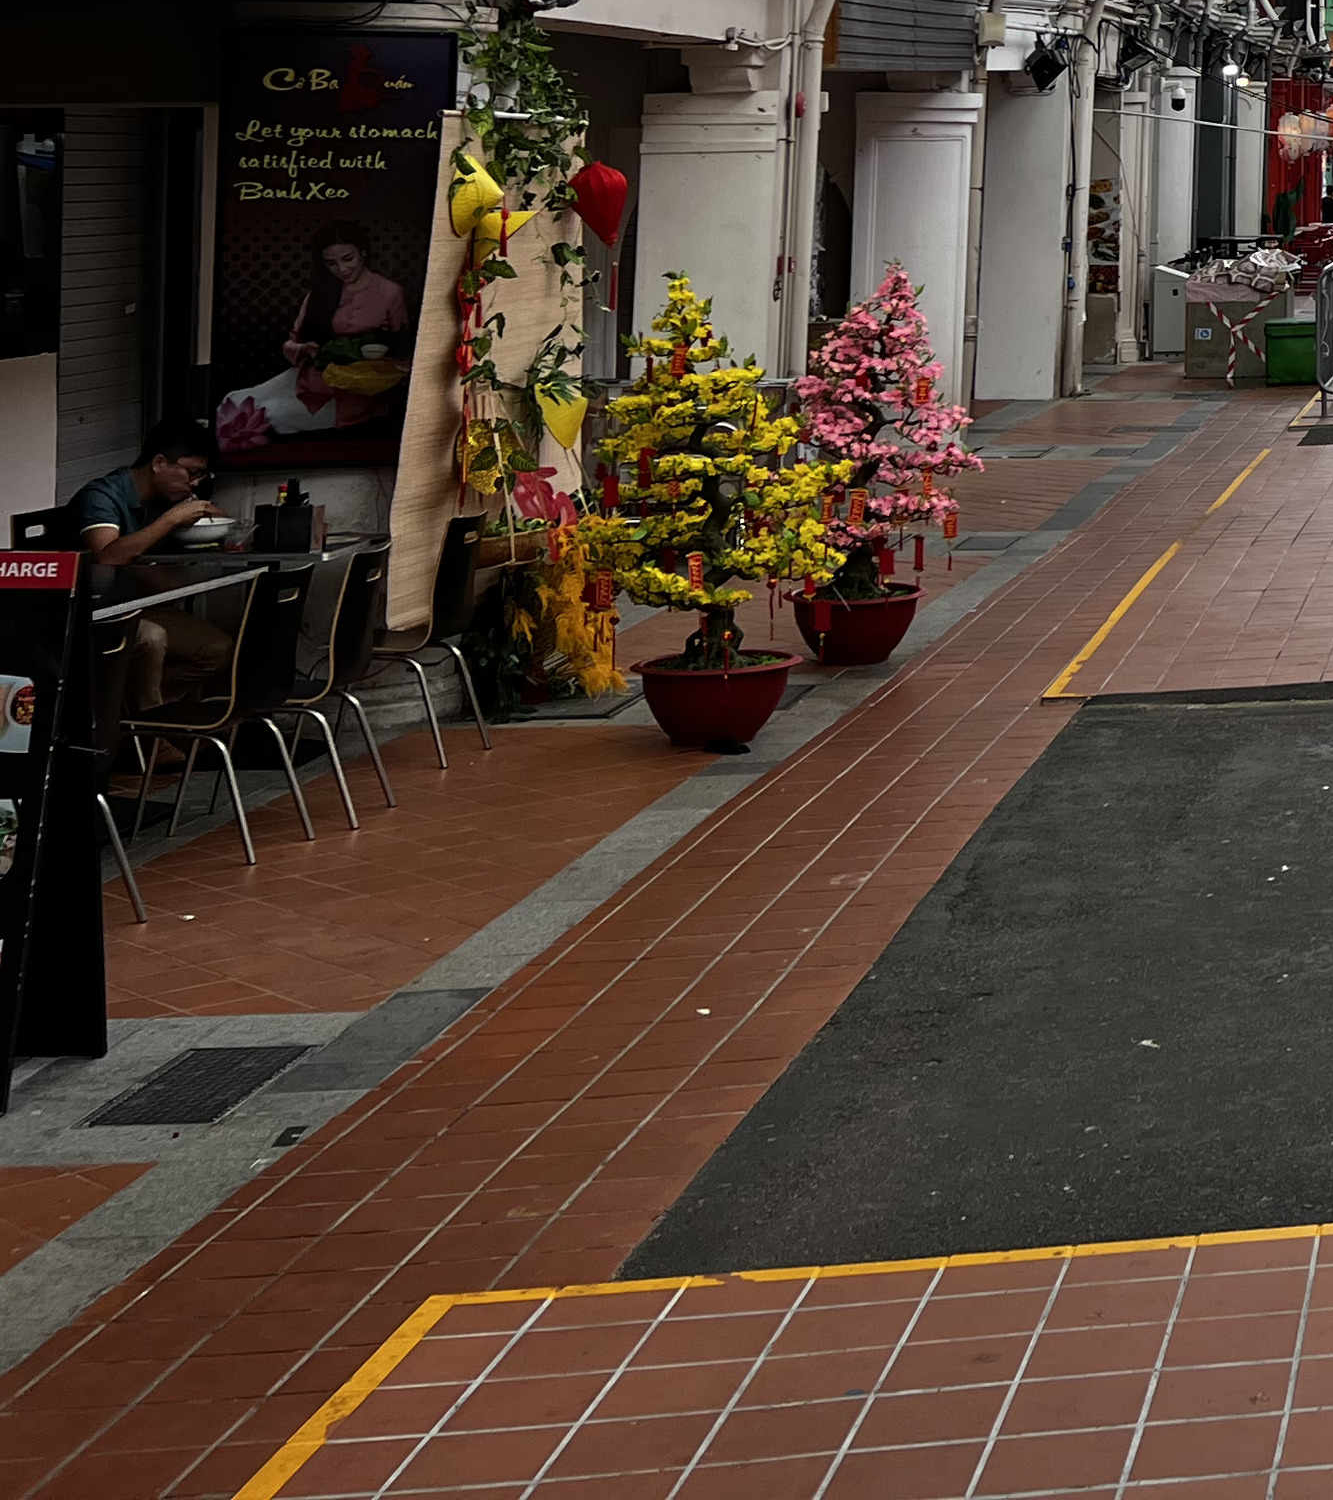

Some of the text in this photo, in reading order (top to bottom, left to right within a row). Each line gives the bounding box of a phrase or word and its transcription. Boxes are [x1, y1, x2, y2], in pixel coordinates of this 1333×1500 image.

[235, 119, 439, 147] Let your stomach
[238, 150, 389, 178] satisfied with
[232, 181, 351, 201] Banh Xeo
